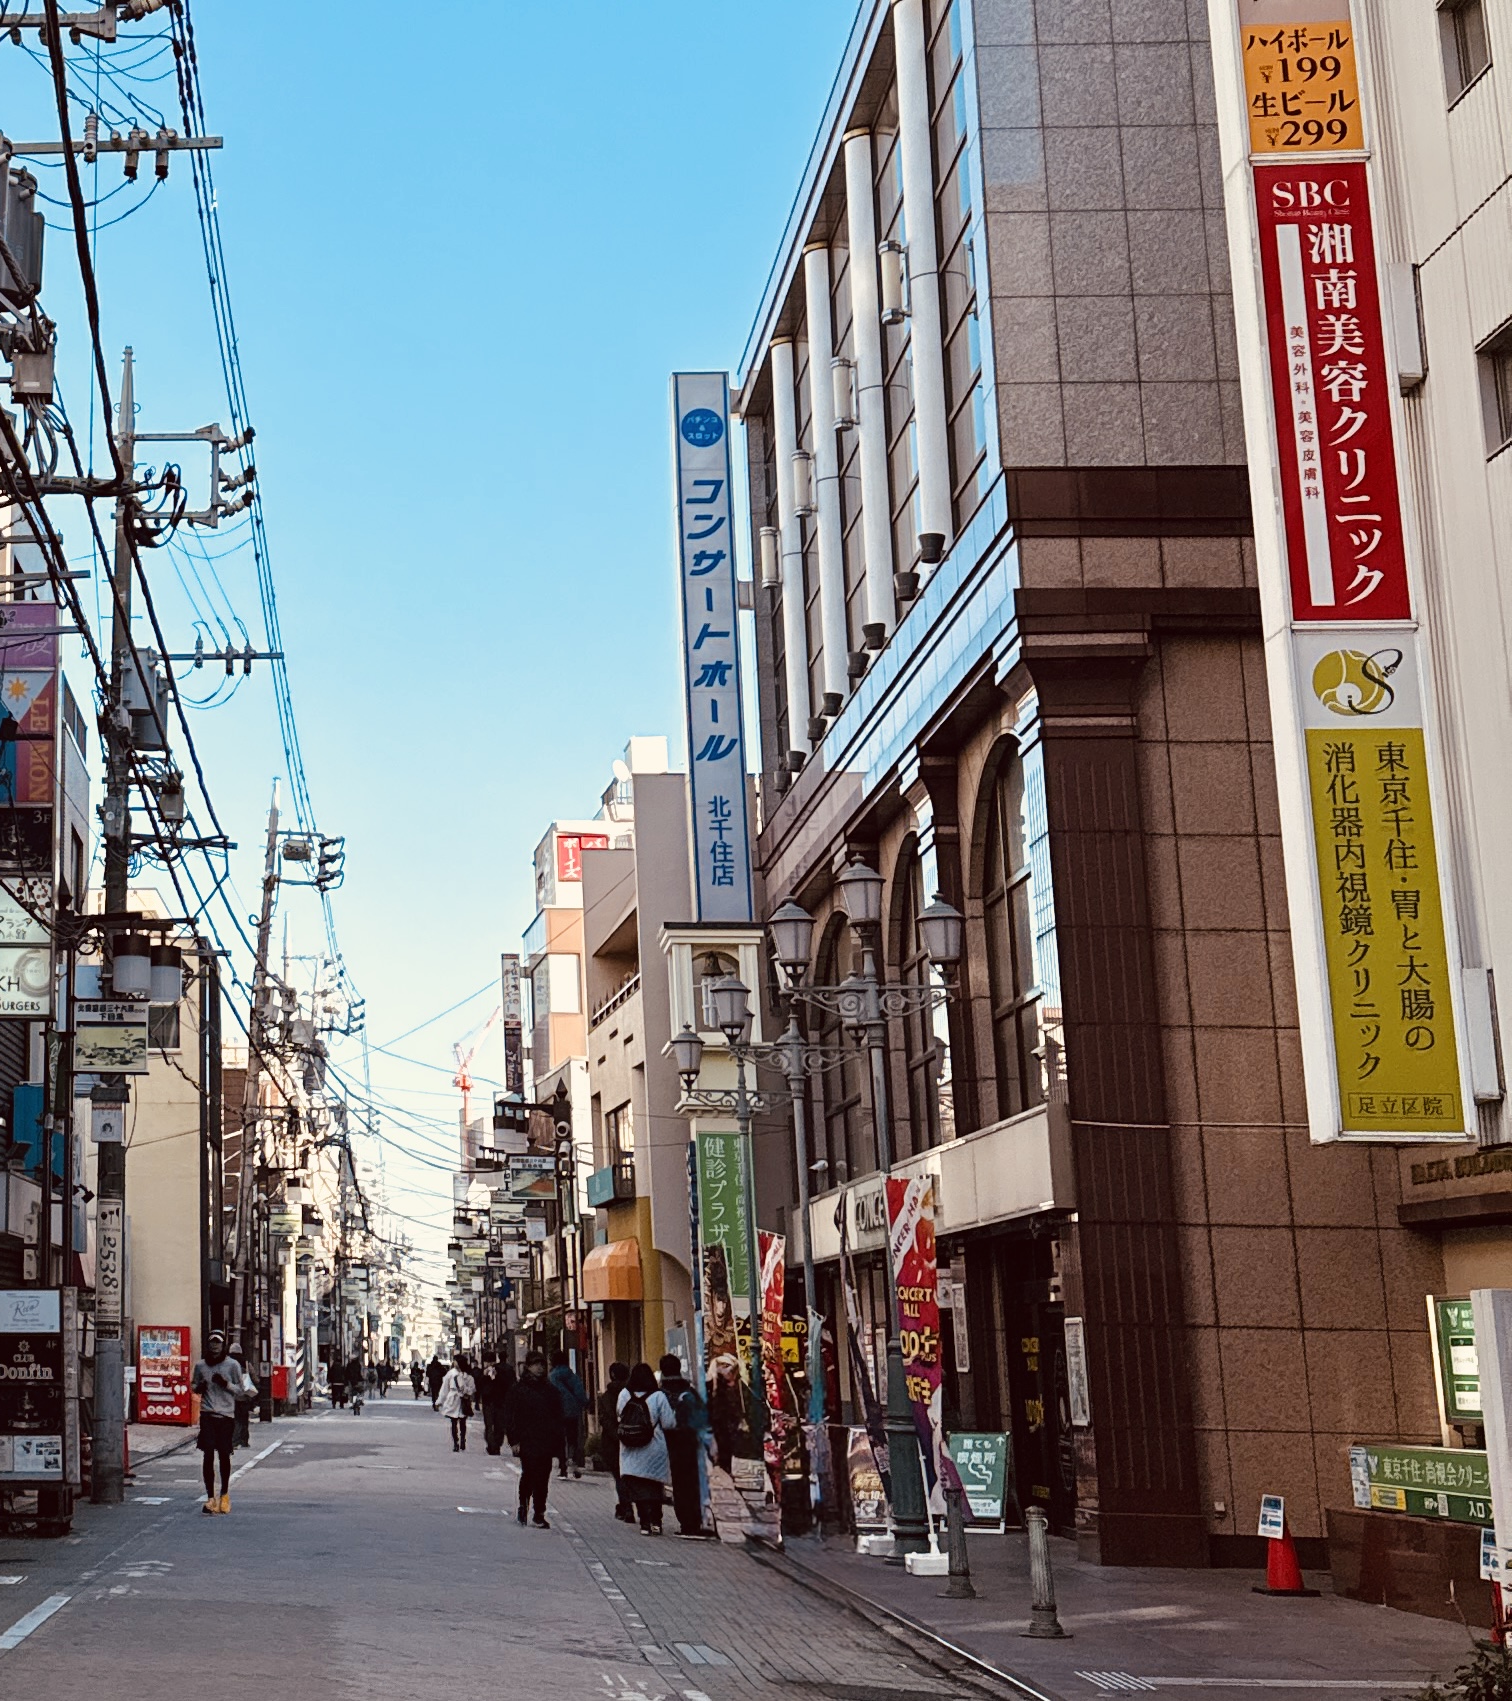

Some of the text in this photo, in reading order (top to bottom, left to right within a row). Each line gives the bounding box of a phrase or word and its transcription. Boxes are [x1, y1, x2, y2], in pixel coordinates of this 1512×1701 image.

[1246, 28, 1349, 54] ハイボール
[1252, 89, 1356, 118] 生ビール
[1272, 179, 1350, 209] SBC
[1307, 223, 1385, 607] 湘南美容クリニック
[685, 479, 738, 761] コンサートホール
[563, 838, 581, 878] ボーイズ
[708, 795, 735, 887] 北千住店
[1322, 742, 1381, 1080] 消化器内視鏡クリニック
[1375, 741, 1435, 1051] 東京千住・胃と大腸の
[1358, 1096, 1444, 1116] 足立区院
[704, 1136, 731, 1245] 健診プラザ
